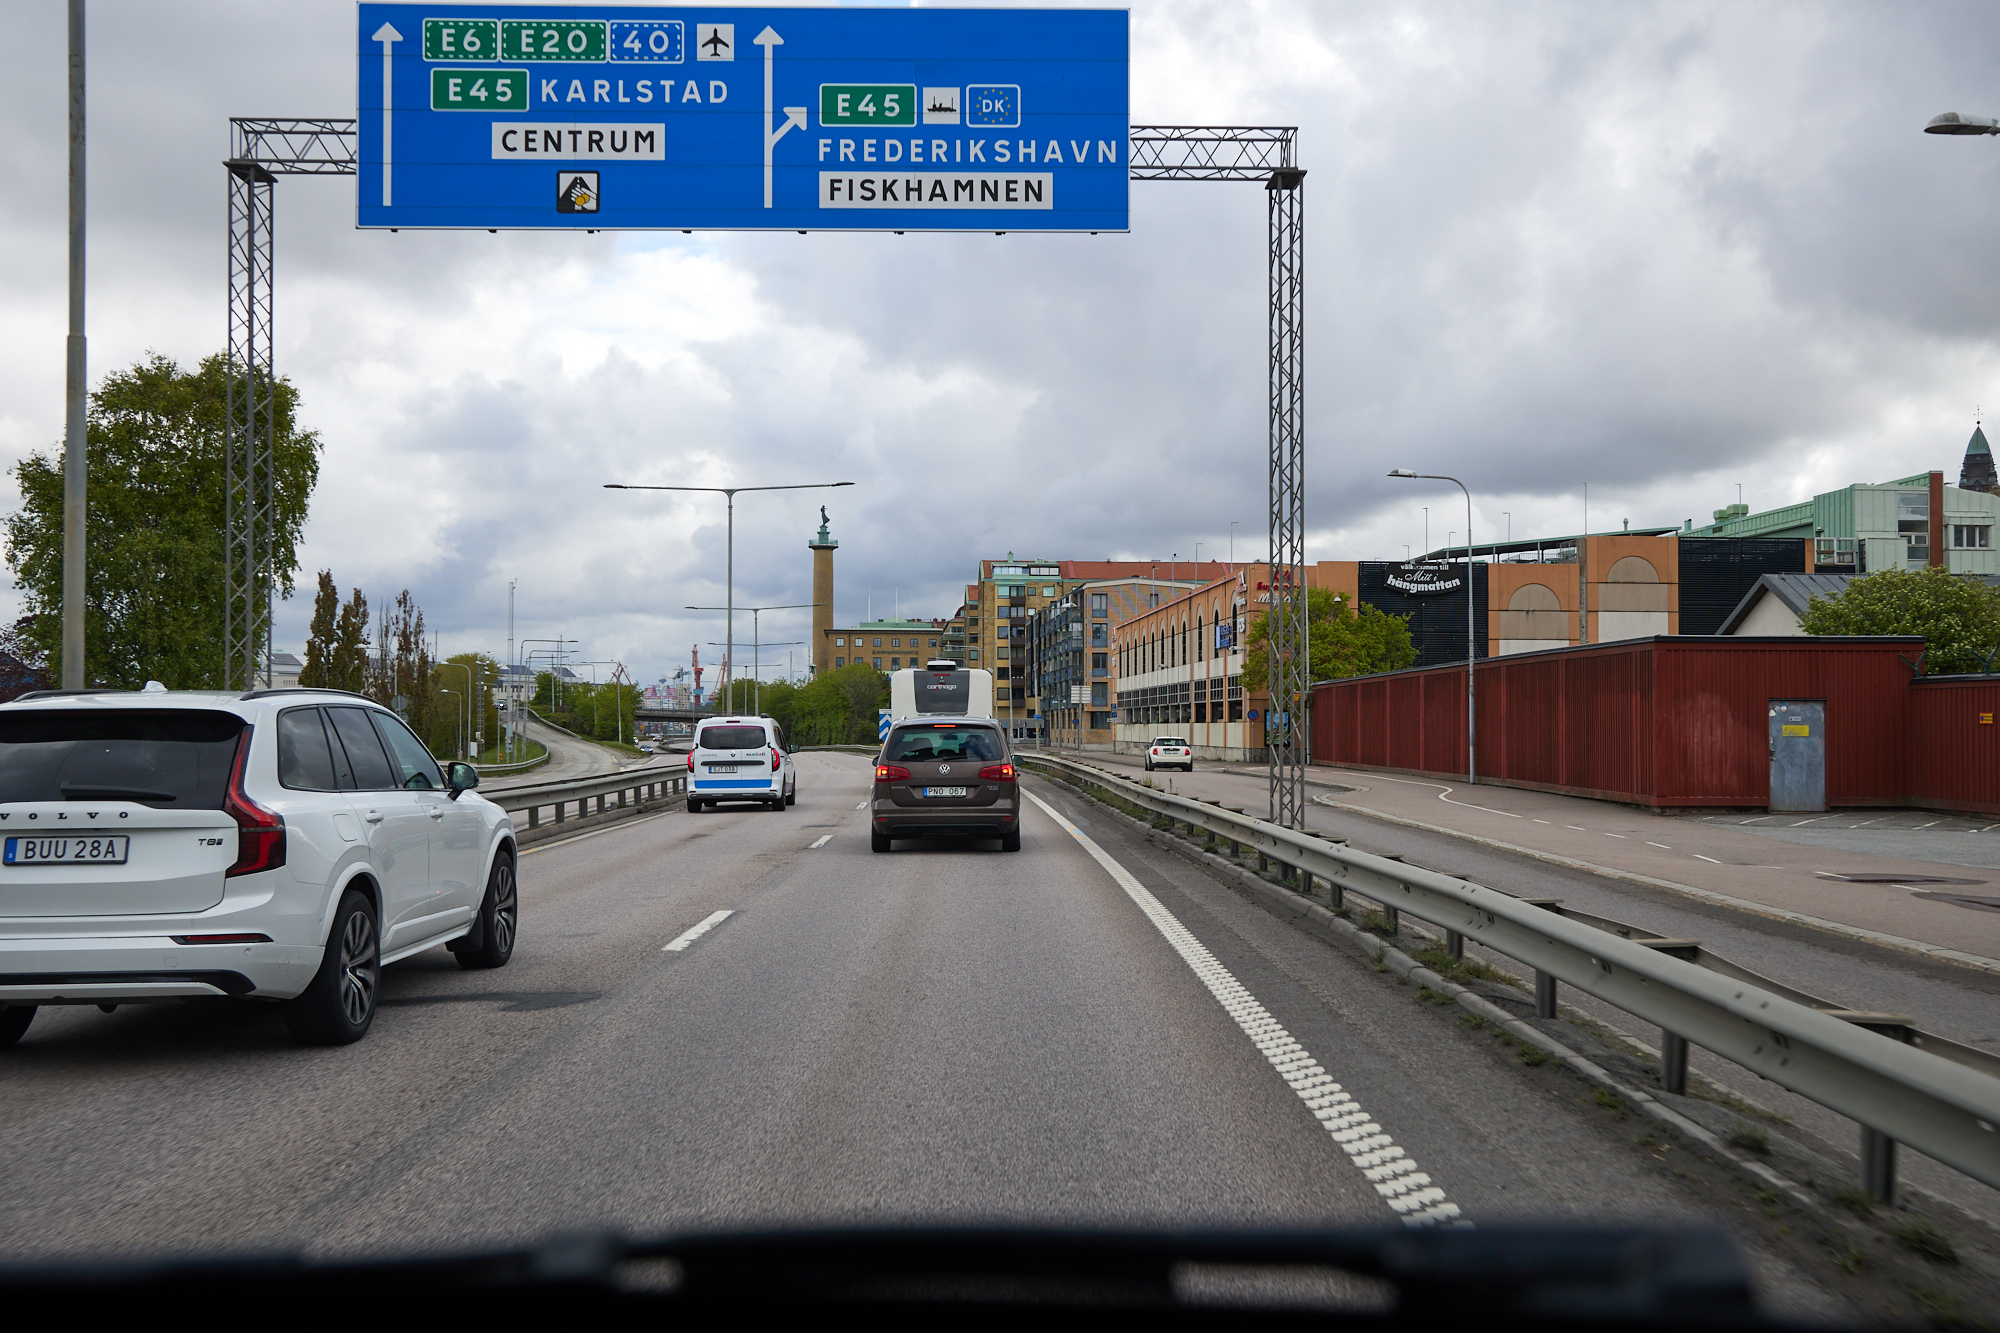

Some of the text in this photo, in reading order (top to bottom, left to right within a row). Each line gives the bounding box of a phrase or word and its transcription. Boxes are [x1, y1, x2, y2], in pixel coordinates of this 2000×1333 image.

[441, 28, 482, 52] E6
[521, 29, 587, 53] E20
[623, 30, 669, 54] 40
[448, 78, 513, 102] E45
[541, 79, 728, 104] KARLSTAD
[837, 93, 901, 118] E45
[982, 99, 1005, 114] DK
[501, 129, 656, 153] CENTRUM
[819, 138, 1117, 164] FREDERIKSHAVN
[829, 178, 1043, 202] FISKHAMNEN
[1386, 573, 1461, 594] hängmattan
[1404, 570, 1433, 582] Mitt
[0, 811, 129, 820] VOLVO
[24, 839, 116, 860] BUU 28A
